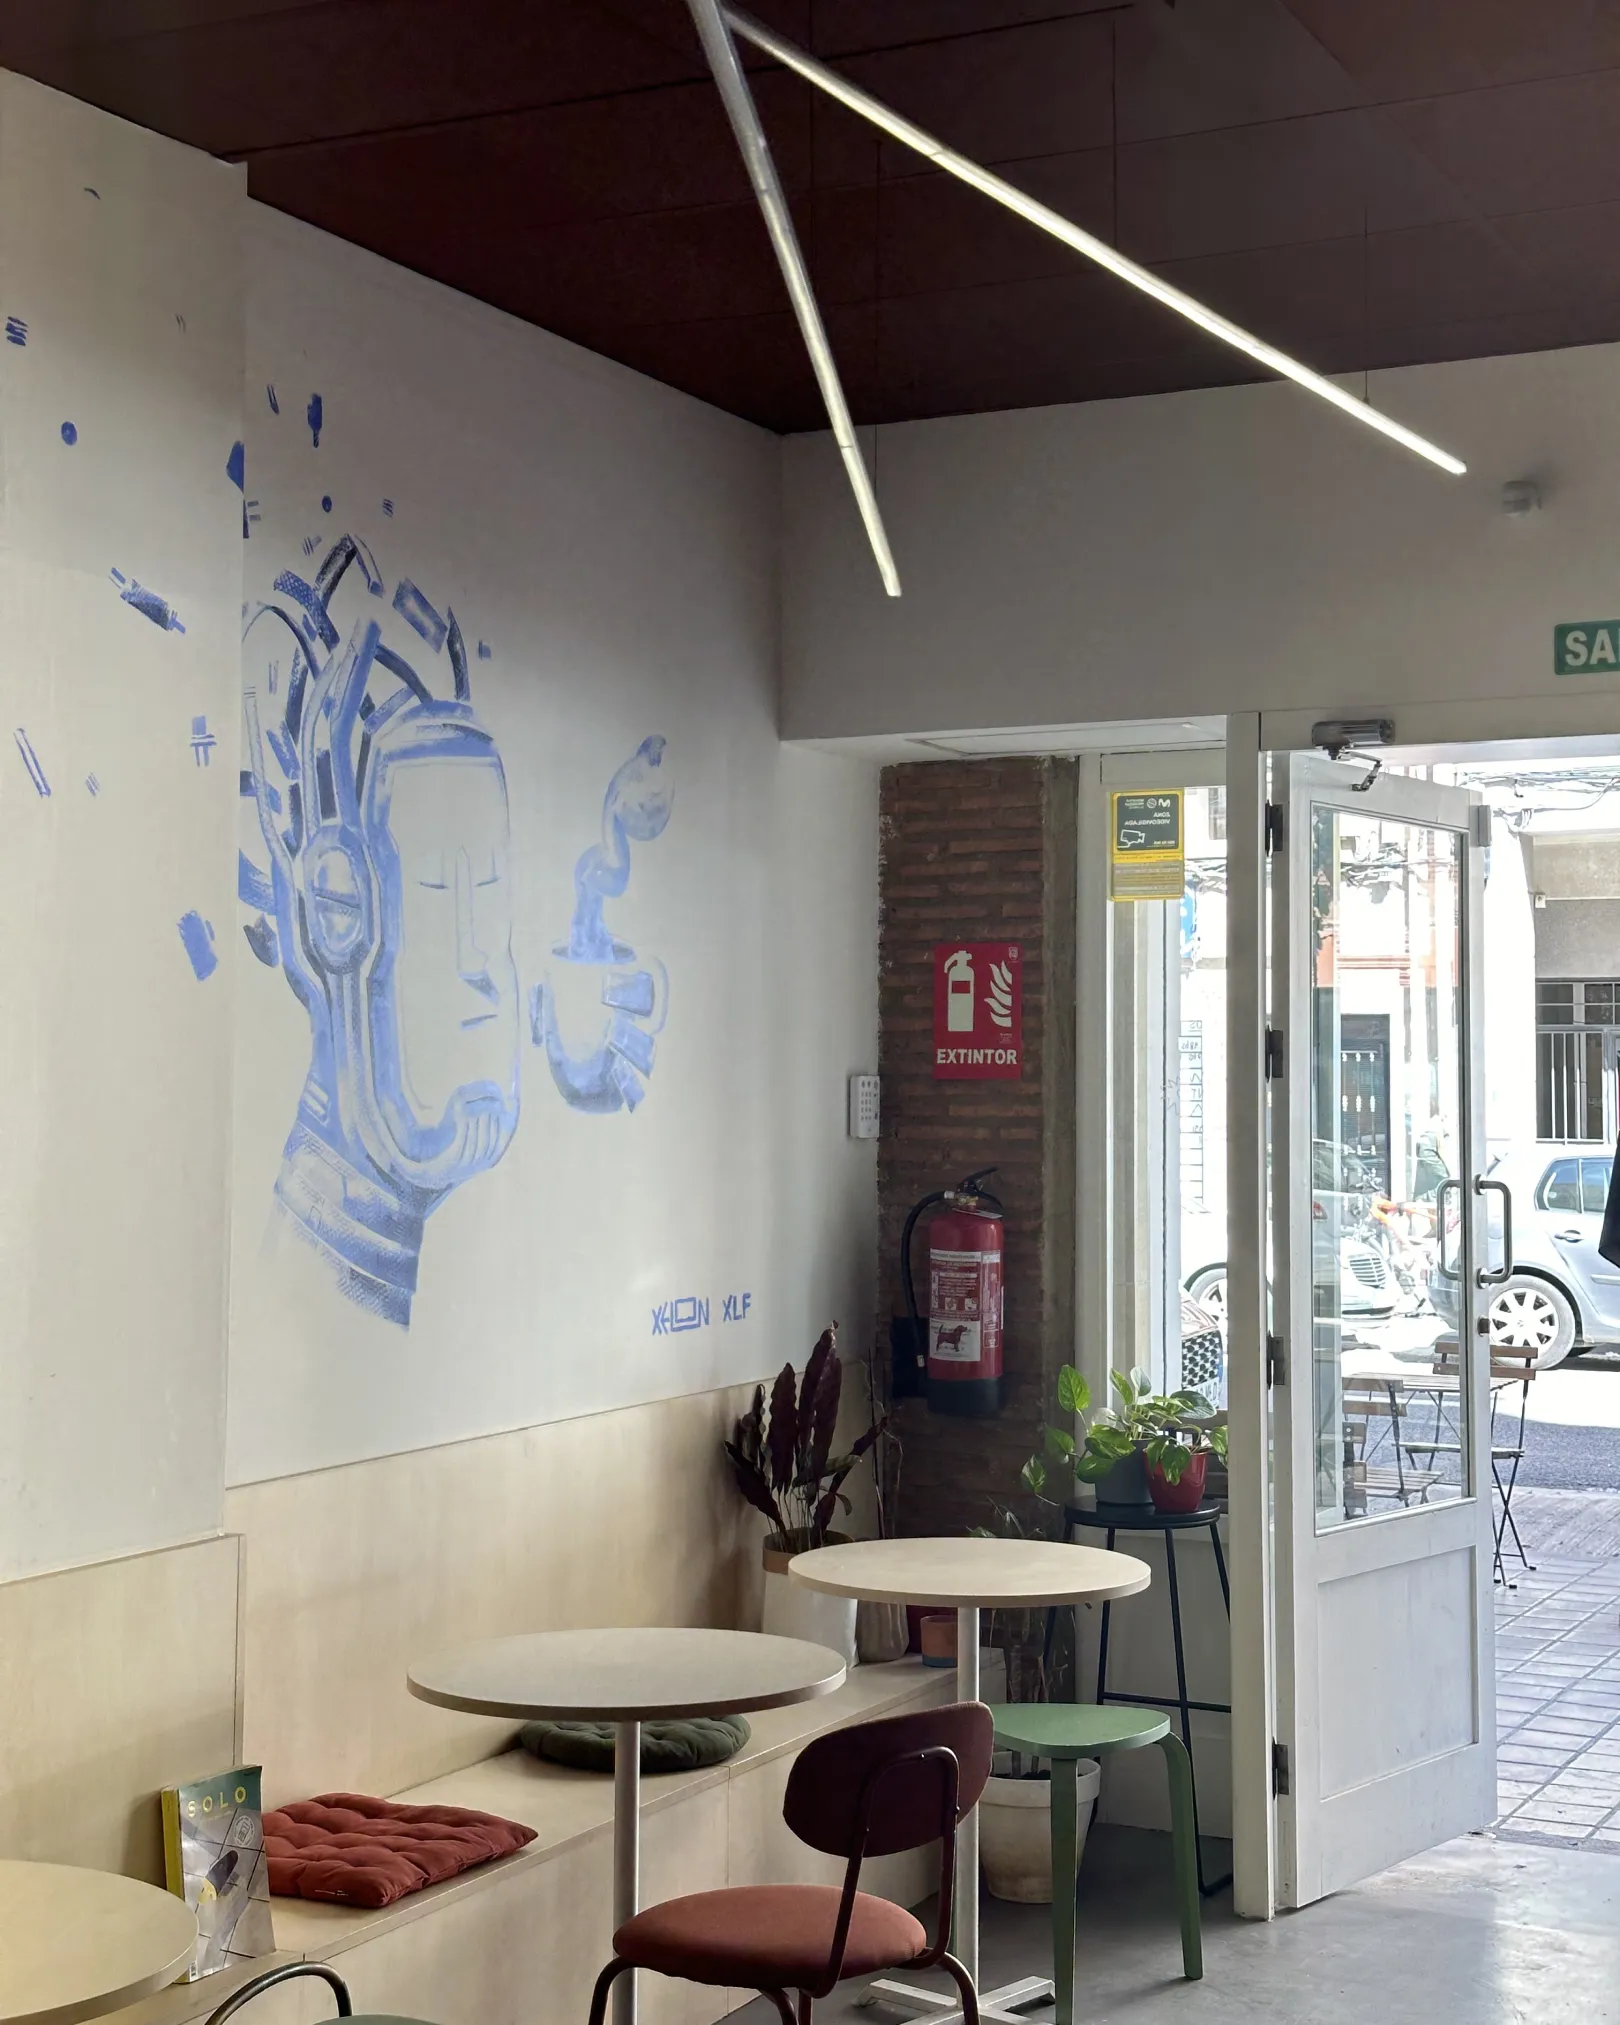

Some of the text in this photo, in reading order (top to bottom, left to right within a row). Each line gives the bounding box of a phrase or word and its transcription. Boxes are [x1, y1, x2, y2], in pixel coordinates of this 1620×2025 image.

[1565, 627, 1620, 666] SA
[936, 1048, 1018, 1065] EXTINTOR
[722, 1292, 751, 1323] XLF
[187, 1786, 246, 1818] SOLO
